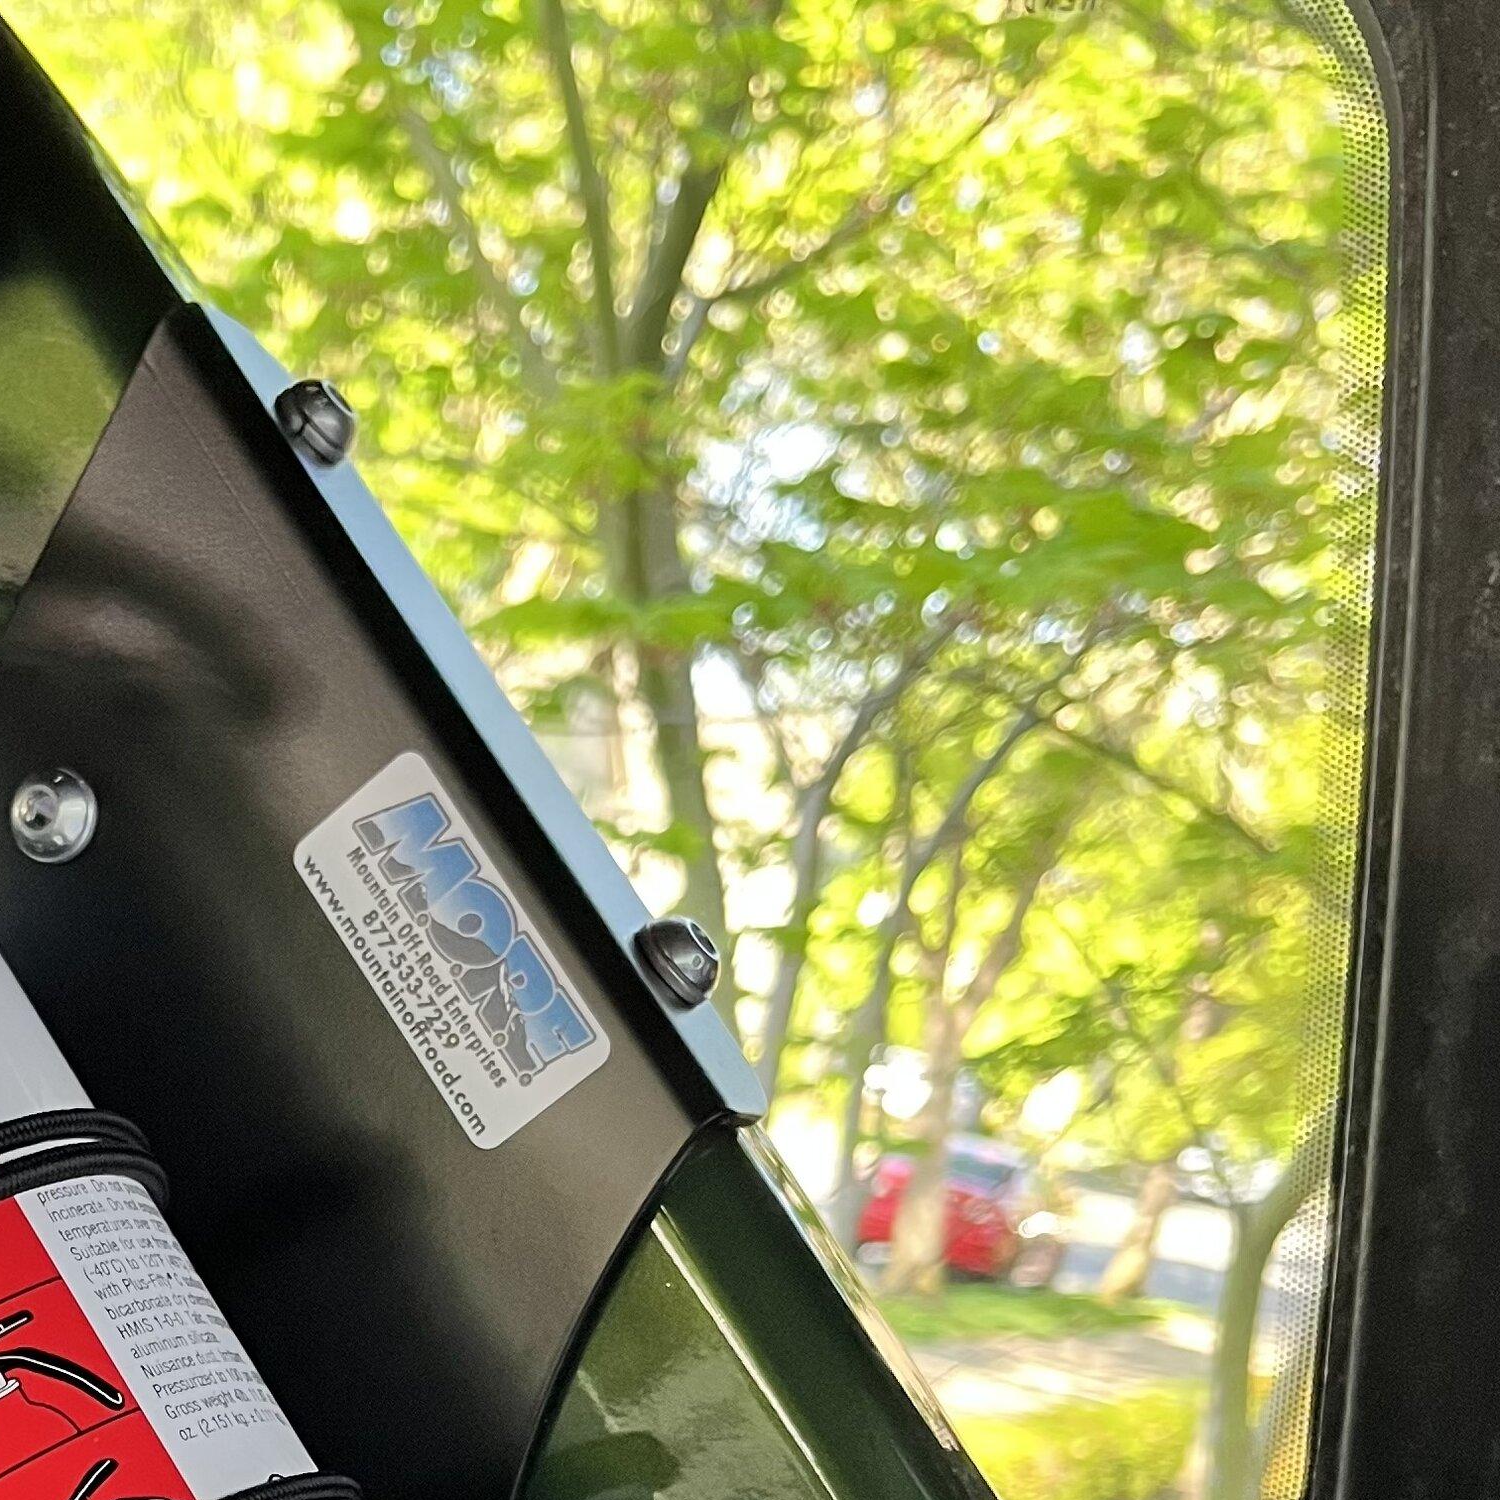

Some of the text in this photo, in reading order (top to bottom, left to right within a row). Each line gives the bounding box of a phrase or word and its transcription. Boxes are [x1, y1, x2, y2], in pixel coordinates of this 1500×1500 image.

[345, 846, 509, 1090] Mountain Off-Road Enterprises
[361, 909, 461, 1049] 877-533-7229
[303, 855, 486, 1138] www.mountainoffroad.com
[58, 1219, 133, 1242] temperatures
[70, 1238, 121, 1261] Suitable
[125, 1256, 140, 1270] to
[94, 1280, 122, 1300] with
[104, 1295, 172, 1320] bicarbonate
[116, 1317, 154, 1340] HMIS
[131, 1335, 188, 1359] aluminum
[140, 1356, 196, 1379] Nuisance
[152, 1371, 217, 1398] Pressurized
[164, 1400, 202, 1419] Gross
